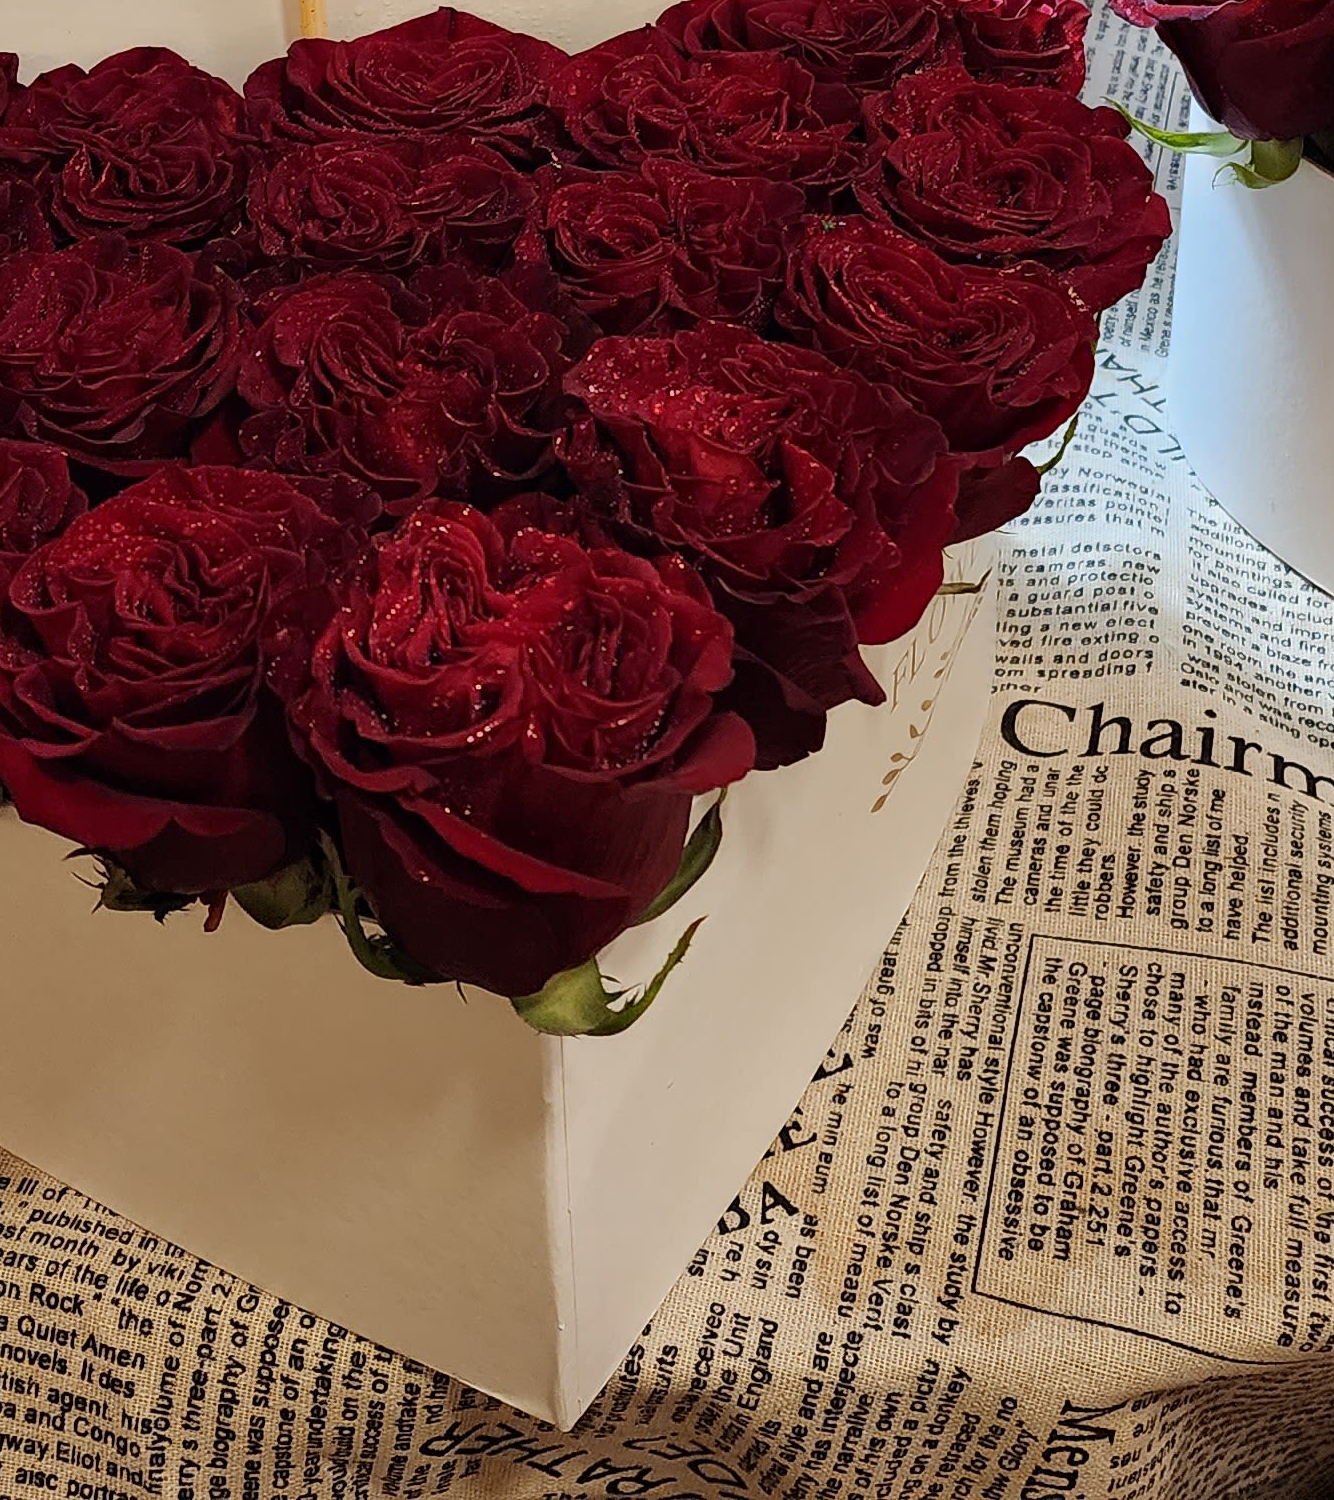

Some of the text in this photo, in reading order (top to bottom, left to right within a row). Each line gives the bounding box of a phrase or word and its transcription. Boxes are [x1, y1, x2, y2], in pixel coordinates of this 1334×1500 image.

[1053, 648, 1154, 664] and doors
[1134, 770, 1155, 809] study
[1127, 812, 1146, 837] the
[1154, 824, 1170, 855] and
[1170, 768, 1200, 930] group Den Norske
[1094, 854, 1116, 921] robbers
[1146, 861, 1170, 916] safety
[1281, 800, 1309, 950] additional security
[1224, 898, 1244, 940] have
[1042, 957, 1064, 985] the
[1162, 973, 1186, 1027] many
[1163, 1034, 1183, 1057] of
[1022, 1087, 1041, 1110] of
[1159, 1062, 1180, 1094] the
[1017, 1115, 1035, 1141] an
[1028, 962, 1088, 1252] Greene was supposed to be
[1115, 962, 1165, 1257] chose to highlight Greene's
[1165, 995, 1211, 1314] who had exclusive access to
[42, 1186, 69, 1202] of
[998, 1150, 1032, 1261] obsessive
[26, 1208, 136, 1245] published
[1139, 1197, 1162, 1277] papers
[29, 1231, 100, 1259] month
[111, 1248, 141, 1273] by
[29, 1283, 85, 1317] Rock
[45, 1258, 72, 1278] of
[74, 1264, 109, 1290] the
[115, 1274, 150, 1302] life
[17, 1315, 146, 1370] Quiet Amen
[24, 1408, 66, 1432] and
[74, 1416, 141, 1458] Congo
